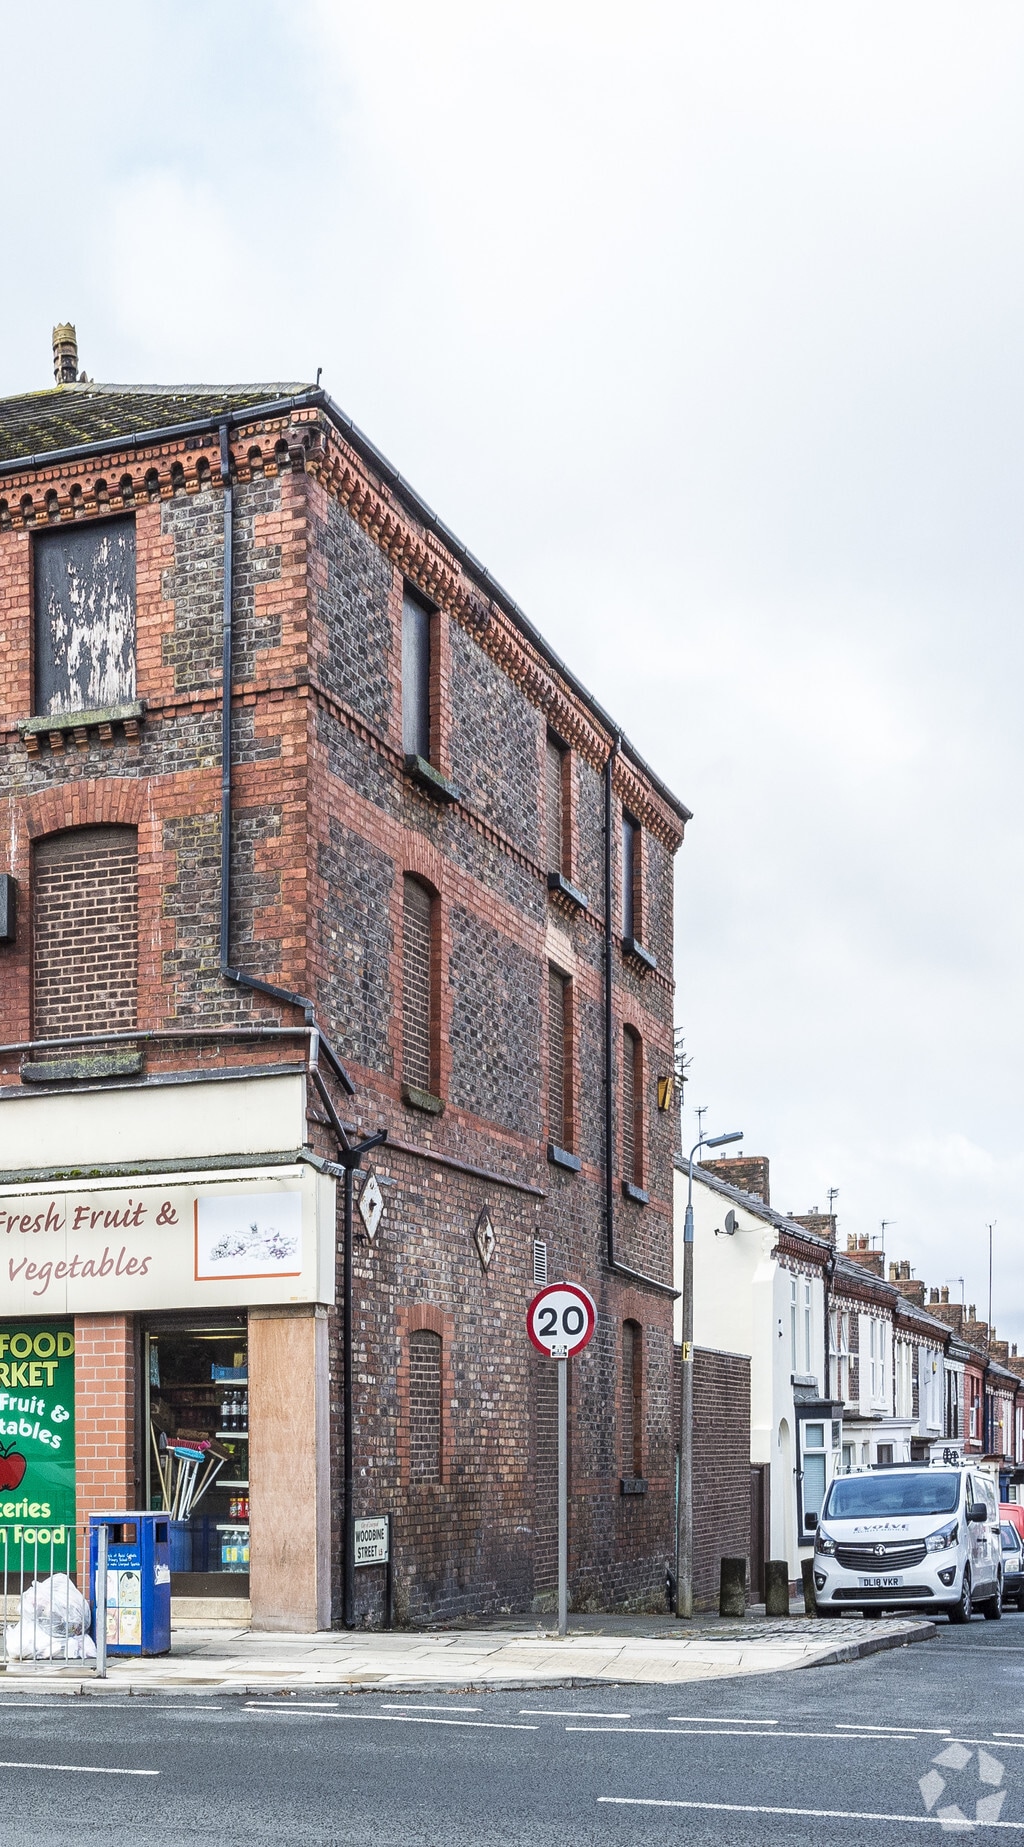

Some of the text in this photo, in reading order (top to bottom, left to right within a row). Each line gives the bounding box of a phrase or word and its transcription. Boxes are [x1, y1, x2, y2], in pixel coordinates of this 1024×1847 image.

[71, 1199, 148, 1231] Fruit
[155, 1201, 179, 1226] &
[8, 1246, 152, 1296] Vegetables
[538, 1306, 584, 1336] 20
[0, 1393, 46, 1416] Fruit
[50, 1404, 70, 1423] &
[14, 1524, 66, 1544] Food
[356, 1528, 384, 1542] WOODBINE
[854, 1522, 910, 1531] evolve
[357, 1545, 377, 1559] STREET
[882, 1578, 898, 1586] VKR
